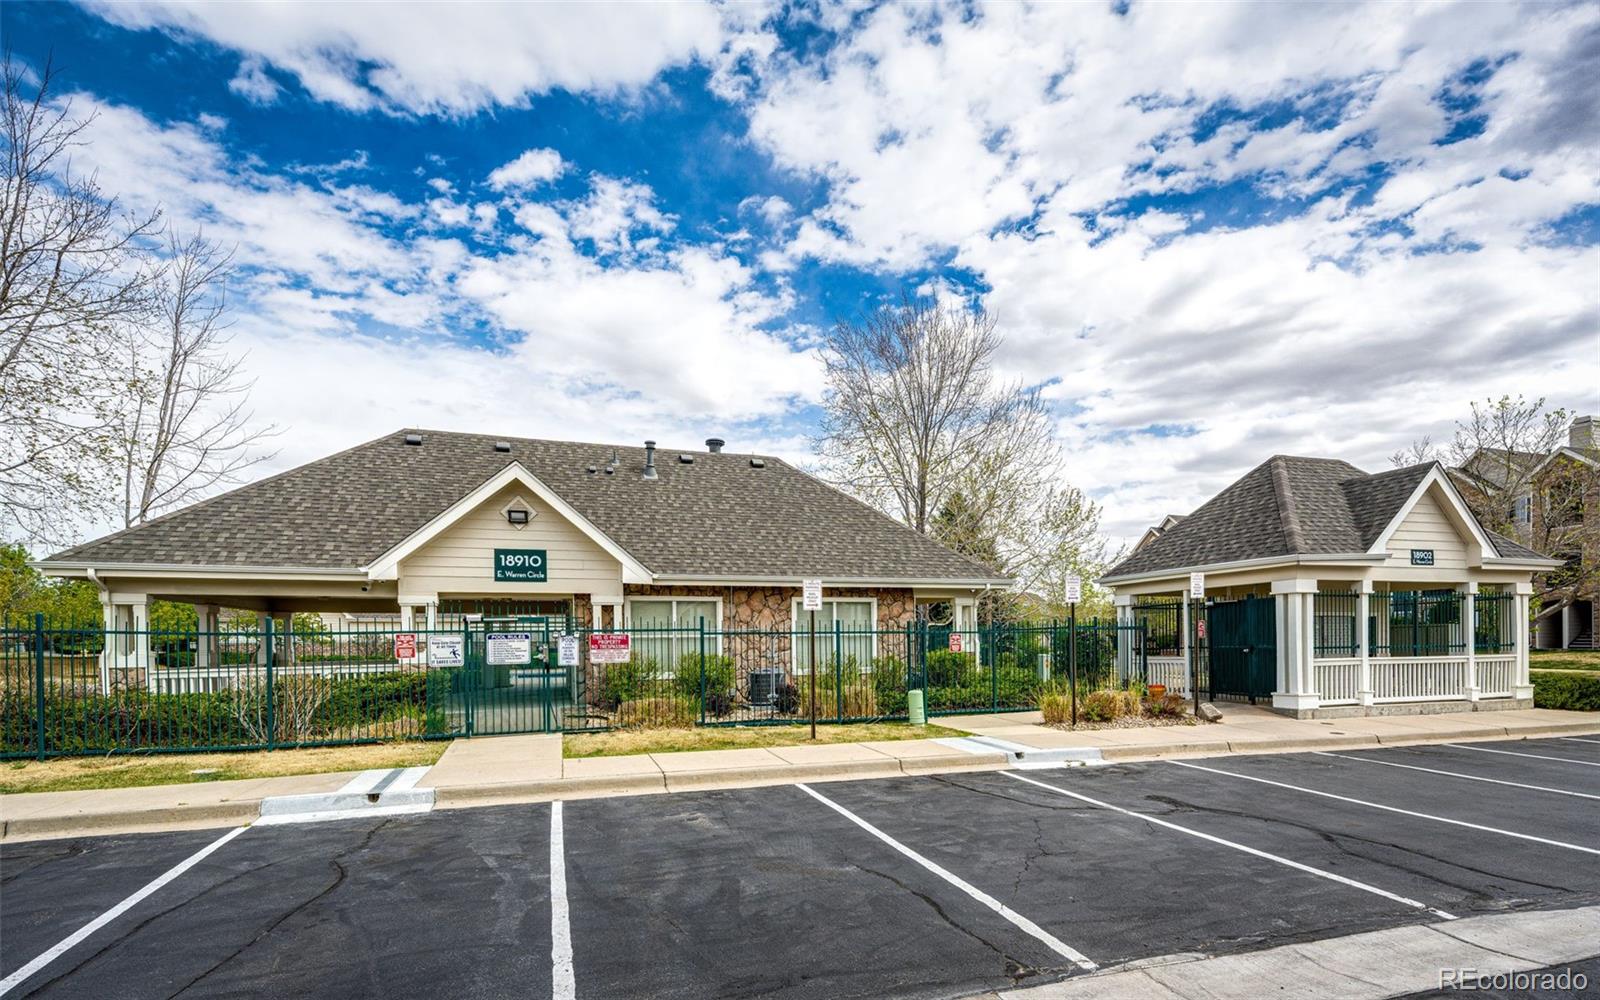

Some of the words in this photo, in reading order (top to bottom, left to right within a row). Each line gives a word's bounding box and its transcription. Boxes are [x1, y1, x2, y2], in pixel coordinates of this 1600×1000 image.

[500, 555, 542, 567] 18910
[497, 570, 504, 578] E.
[505, 570, 527, 578] Warren
[527, 570, 544, 579] Circle
